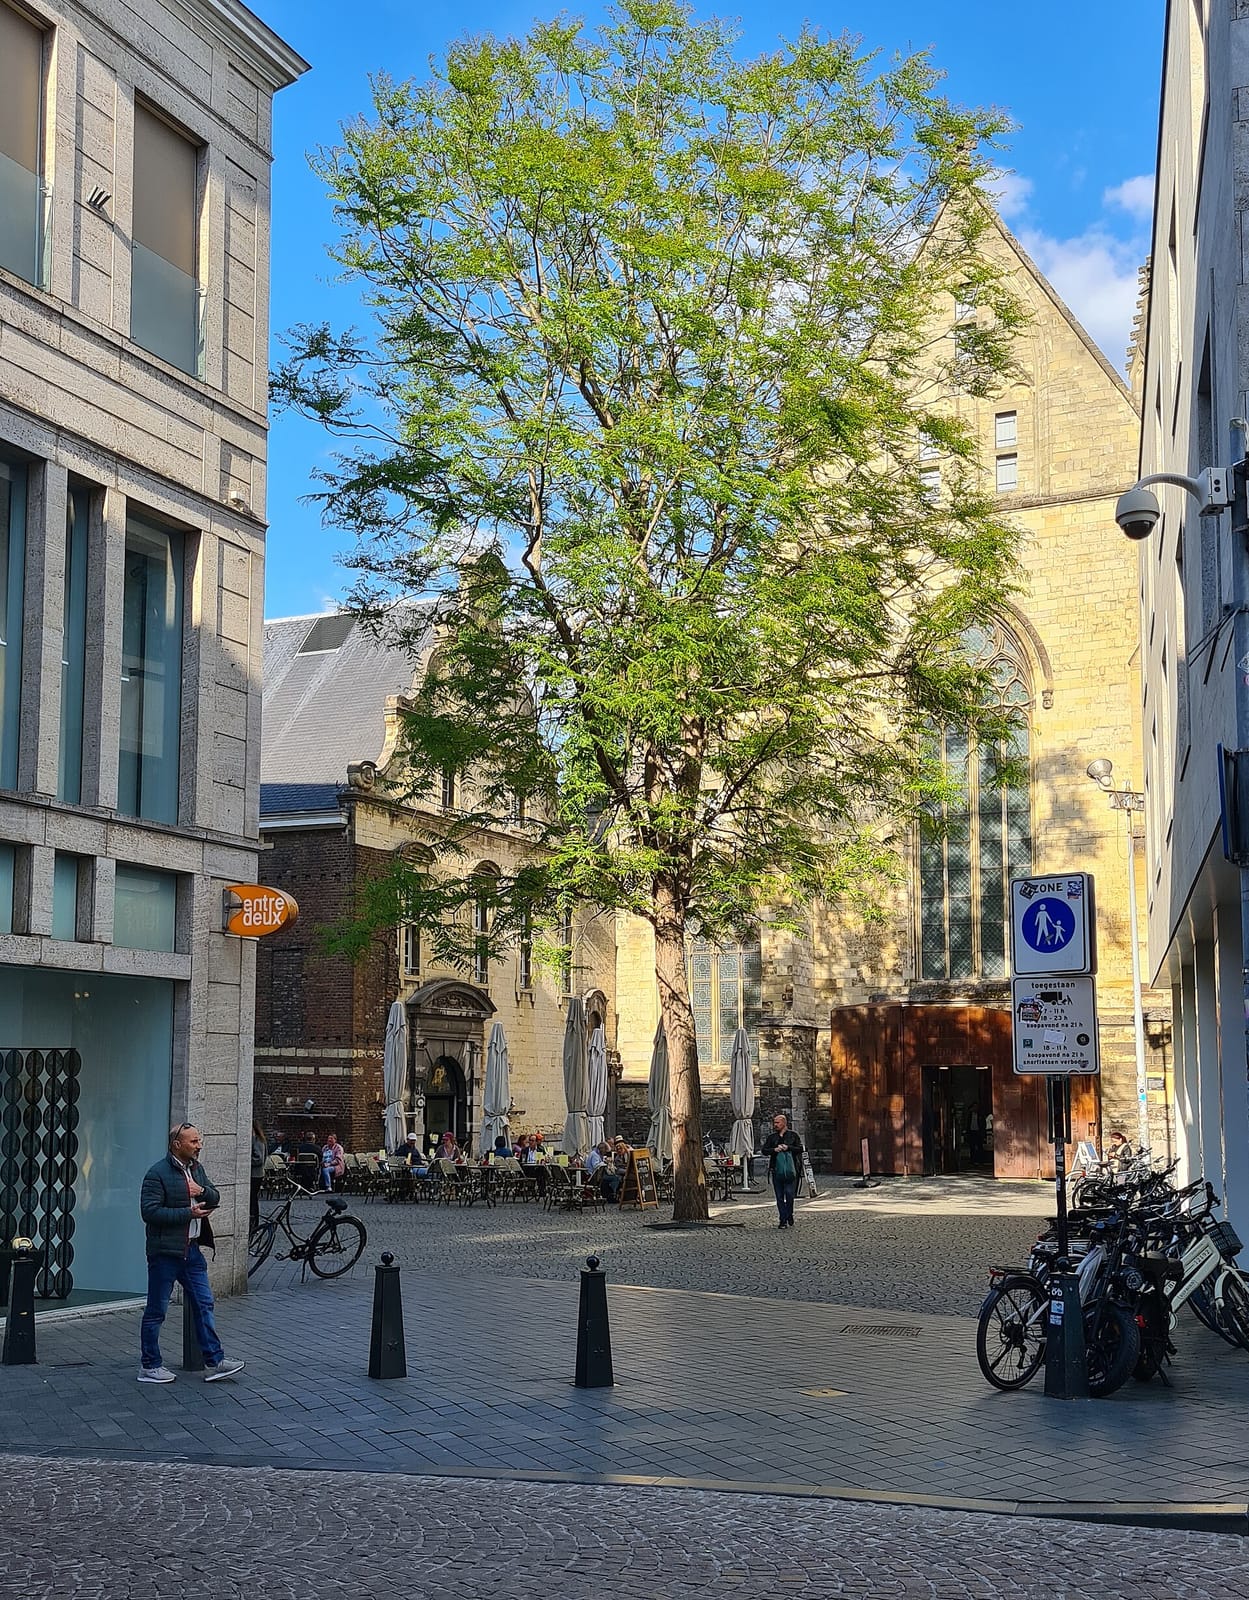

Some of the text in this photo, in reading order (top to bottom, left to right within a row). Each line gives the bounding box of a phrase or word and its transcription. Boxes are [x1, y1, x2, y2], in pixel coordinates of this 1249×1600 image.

[243, 895, 285, 911] entre
[243, 908, 282, 926] deux
[1031, 982, 1075, 990] toegestaan
